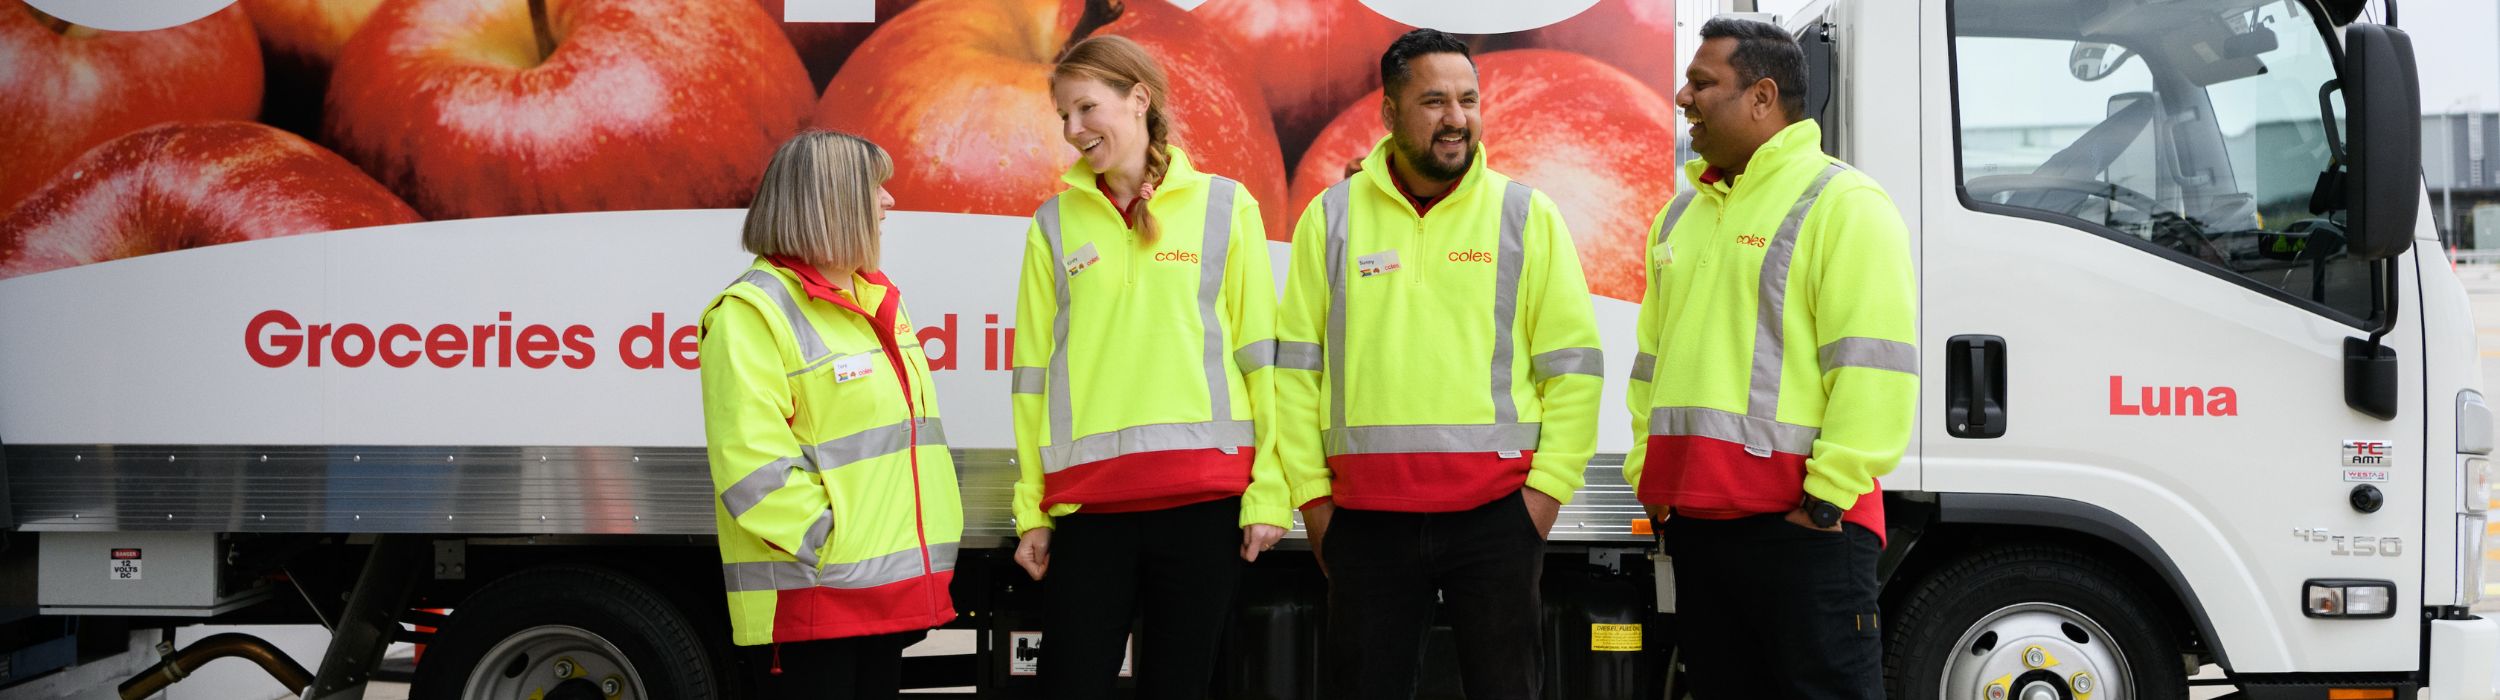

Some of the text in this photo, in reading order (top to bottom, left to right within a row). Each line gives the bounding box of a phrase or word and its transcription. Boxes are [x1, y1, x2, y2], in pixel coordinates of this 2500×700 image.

[1736, 233, 1766, 248] coles
[1155, 249, 1198, 264] coles
[1448, 249, 1492, 264] coles
[245, 310, 595, 370] Groceries
[2110, 376, 2238, 416] Luna
[2352, 442, 2383, 455] TC
[2352, 456, 2383, 464] AMT
[2293, 527, 2402, 557] 45 150
